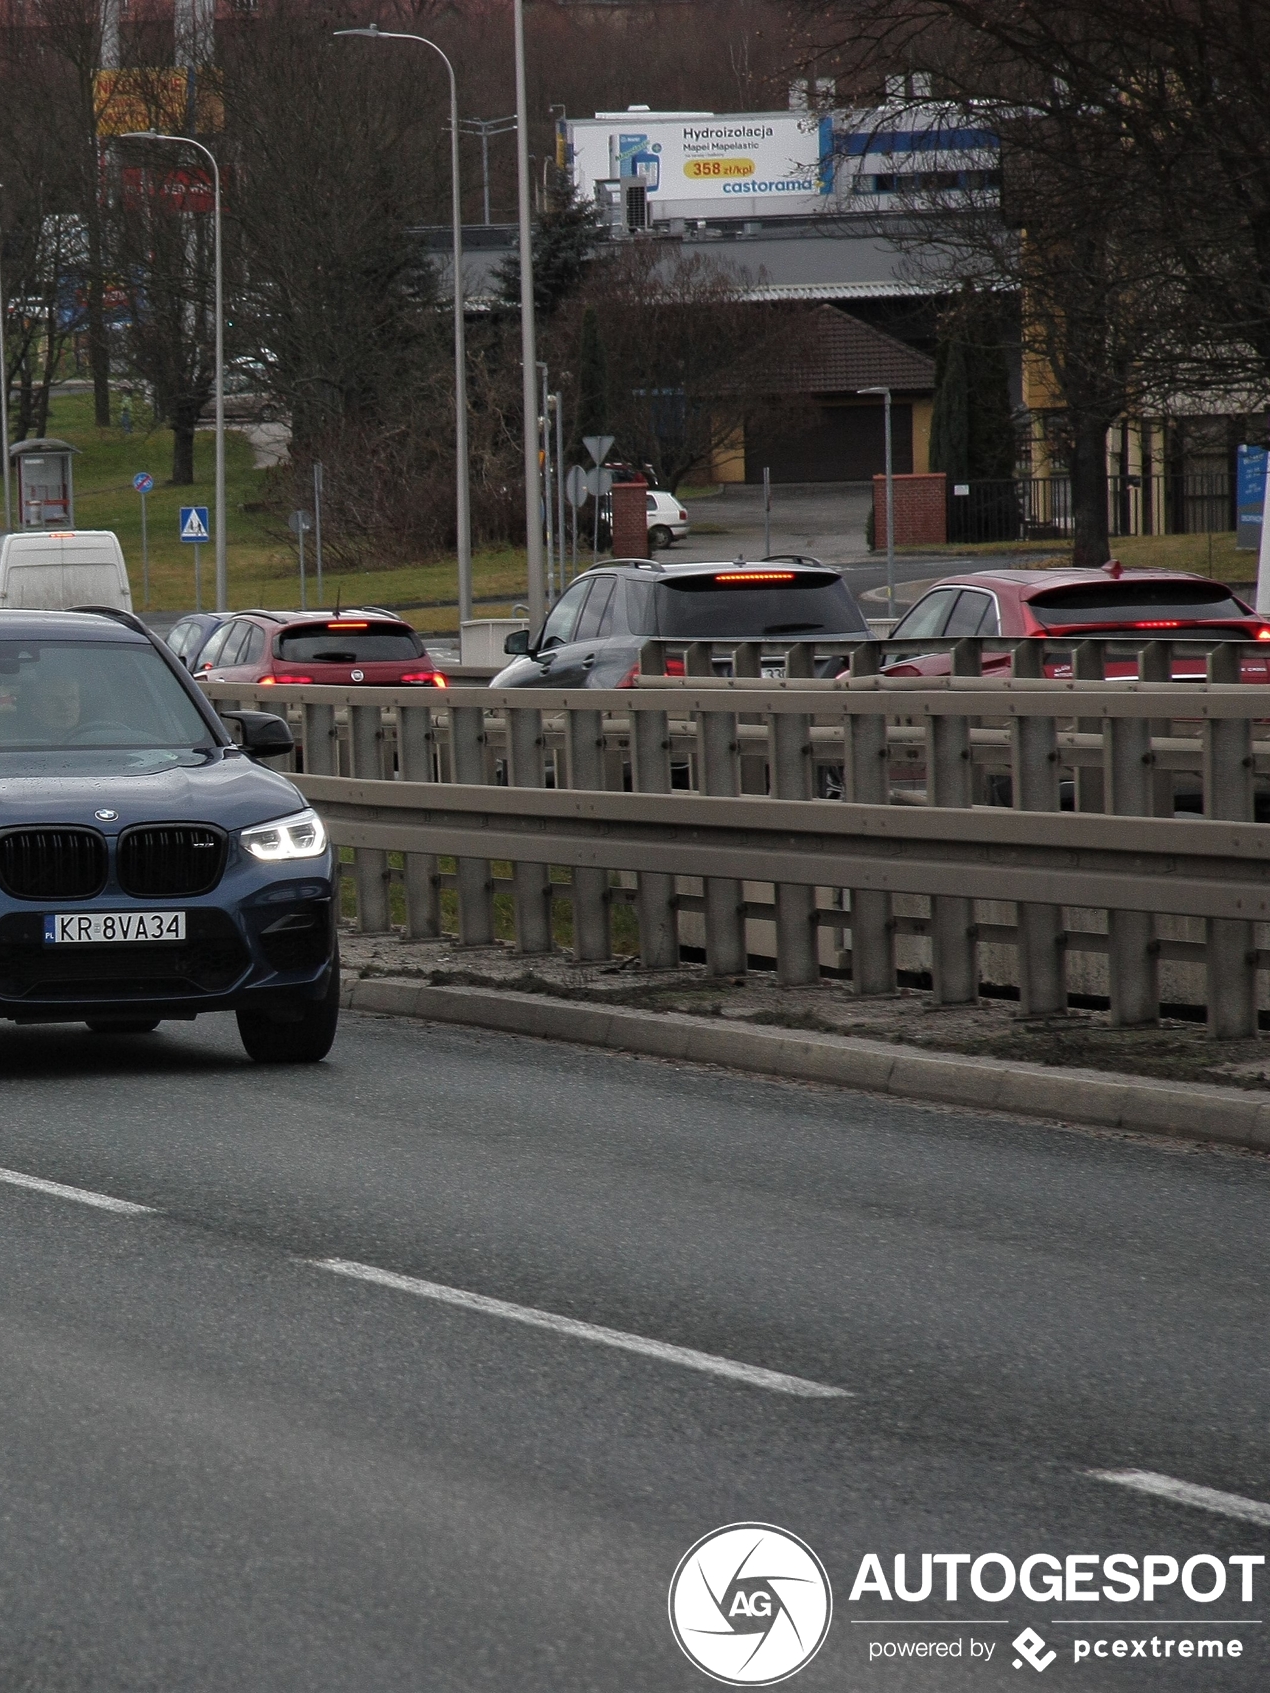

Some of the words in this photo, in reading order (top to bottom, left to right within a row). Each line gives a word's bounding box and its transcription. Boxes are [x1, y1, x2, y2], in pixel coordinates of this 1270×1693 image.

[683, 125, 773, 141] Hydroizolacja
[683, 143, 710, 152] Mapei
[711, 141, 759, 152] Mapelastic
[693, 162, 721, 175] 358
[723, 178, 813, 194] castorama
[60, 917, 92, 940] KR
[103, 915, 179, 940] 8VA34
[45, 932, 54, 940] PL
